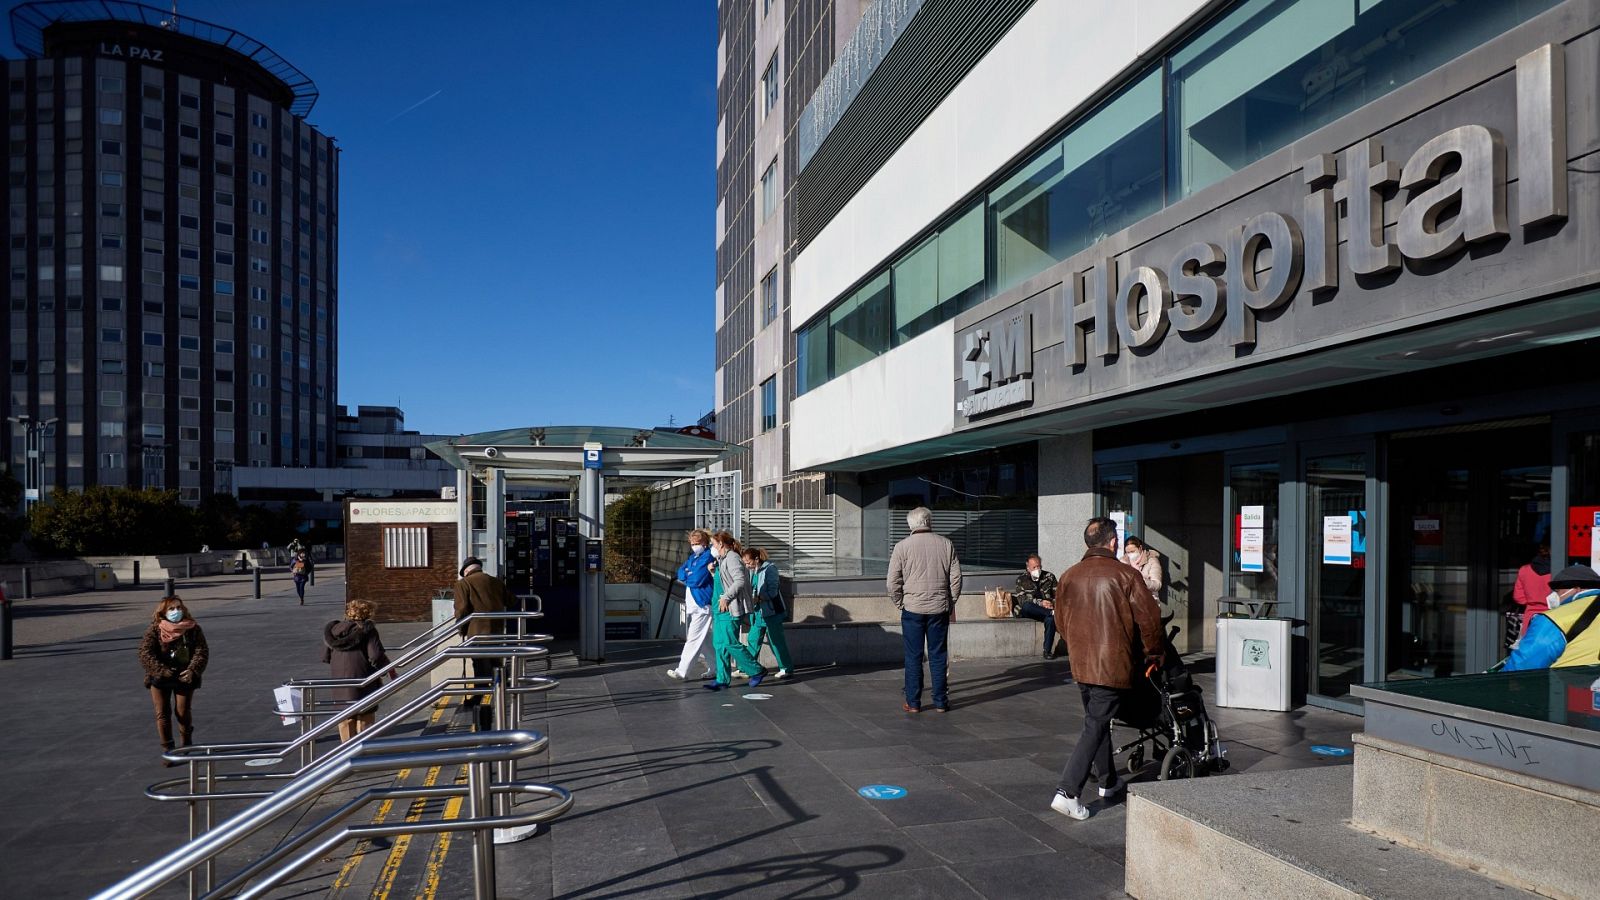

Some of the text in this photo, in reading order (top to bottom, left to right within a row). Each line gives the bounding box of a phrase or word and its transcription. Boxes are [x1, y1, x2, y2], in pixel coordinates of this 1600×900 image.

[101, 42, 164, 61] LA PAZ
[1062, 42, 1568, 368] Hospital
[1431, 720, 1540, 765] MINI
